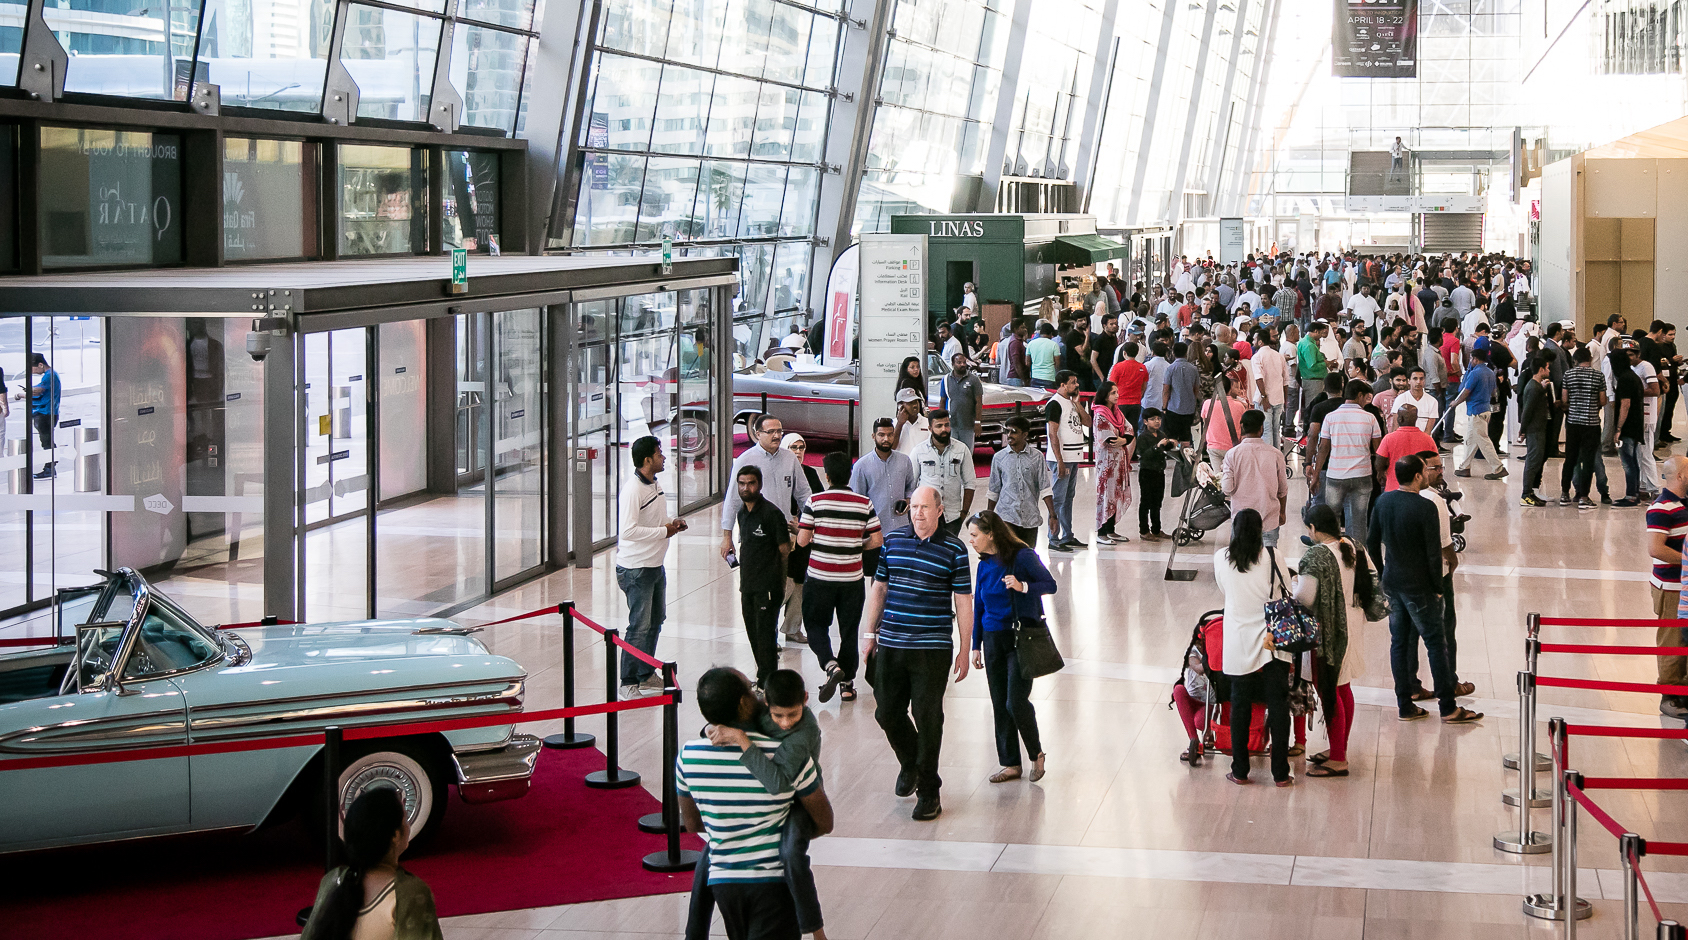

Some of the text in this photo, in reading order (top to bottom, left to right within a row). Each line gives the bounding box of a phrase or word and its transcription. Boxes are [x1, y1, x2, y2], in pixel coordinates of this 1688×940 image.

[1347, 16, 1374, 24] APRIL
[1376, 16, 1385, 24] 18
[1392, 16, 1403, 24] 22
[929, 220, 984, 238] LINA'S
[454, 251, 466, 267] EXIT
